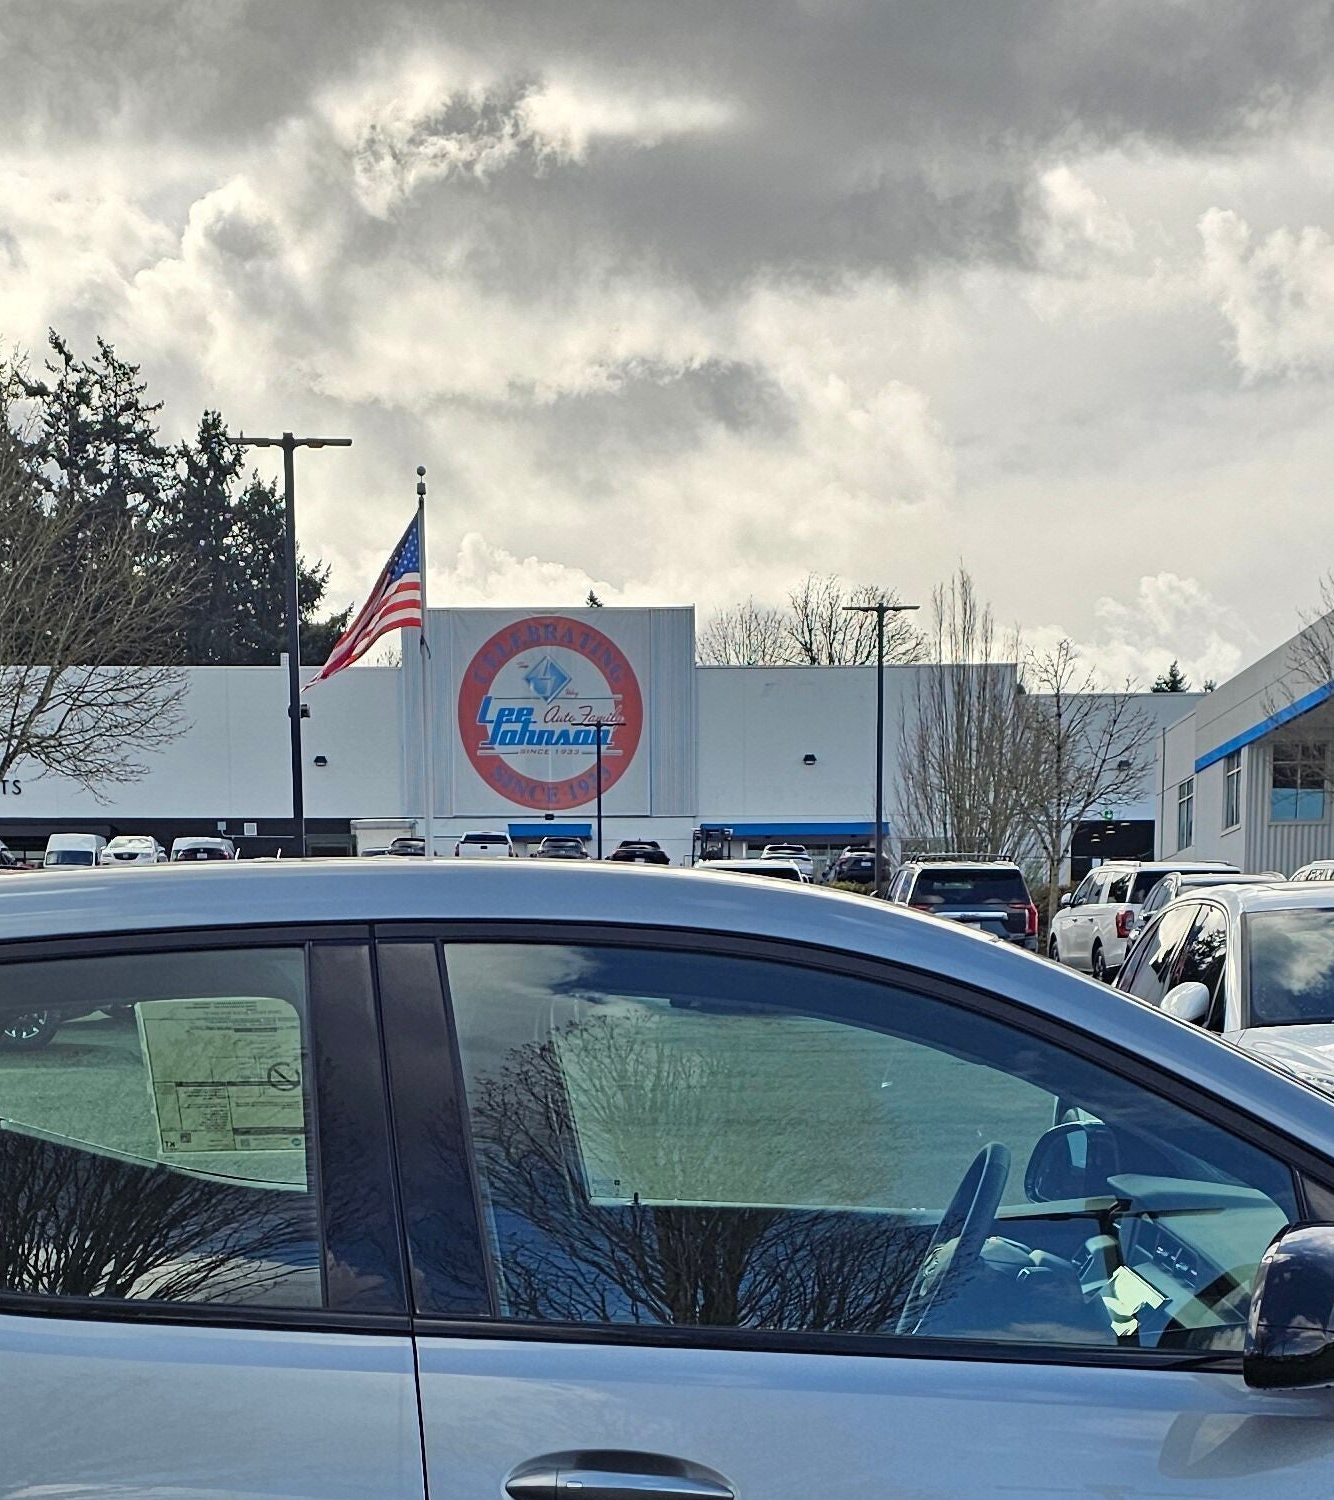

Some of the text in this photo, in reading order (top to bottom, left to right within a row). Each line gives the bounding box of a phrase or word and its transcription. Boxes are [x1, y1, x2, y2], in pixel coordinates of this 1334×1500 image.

[473, 622, 623, 686] CELEBRATING
[476, 695, 626, 728] Lee Auto Family
[479, 714, 615, 747] Johnson
[492, 764, 561, 804] SINCE
